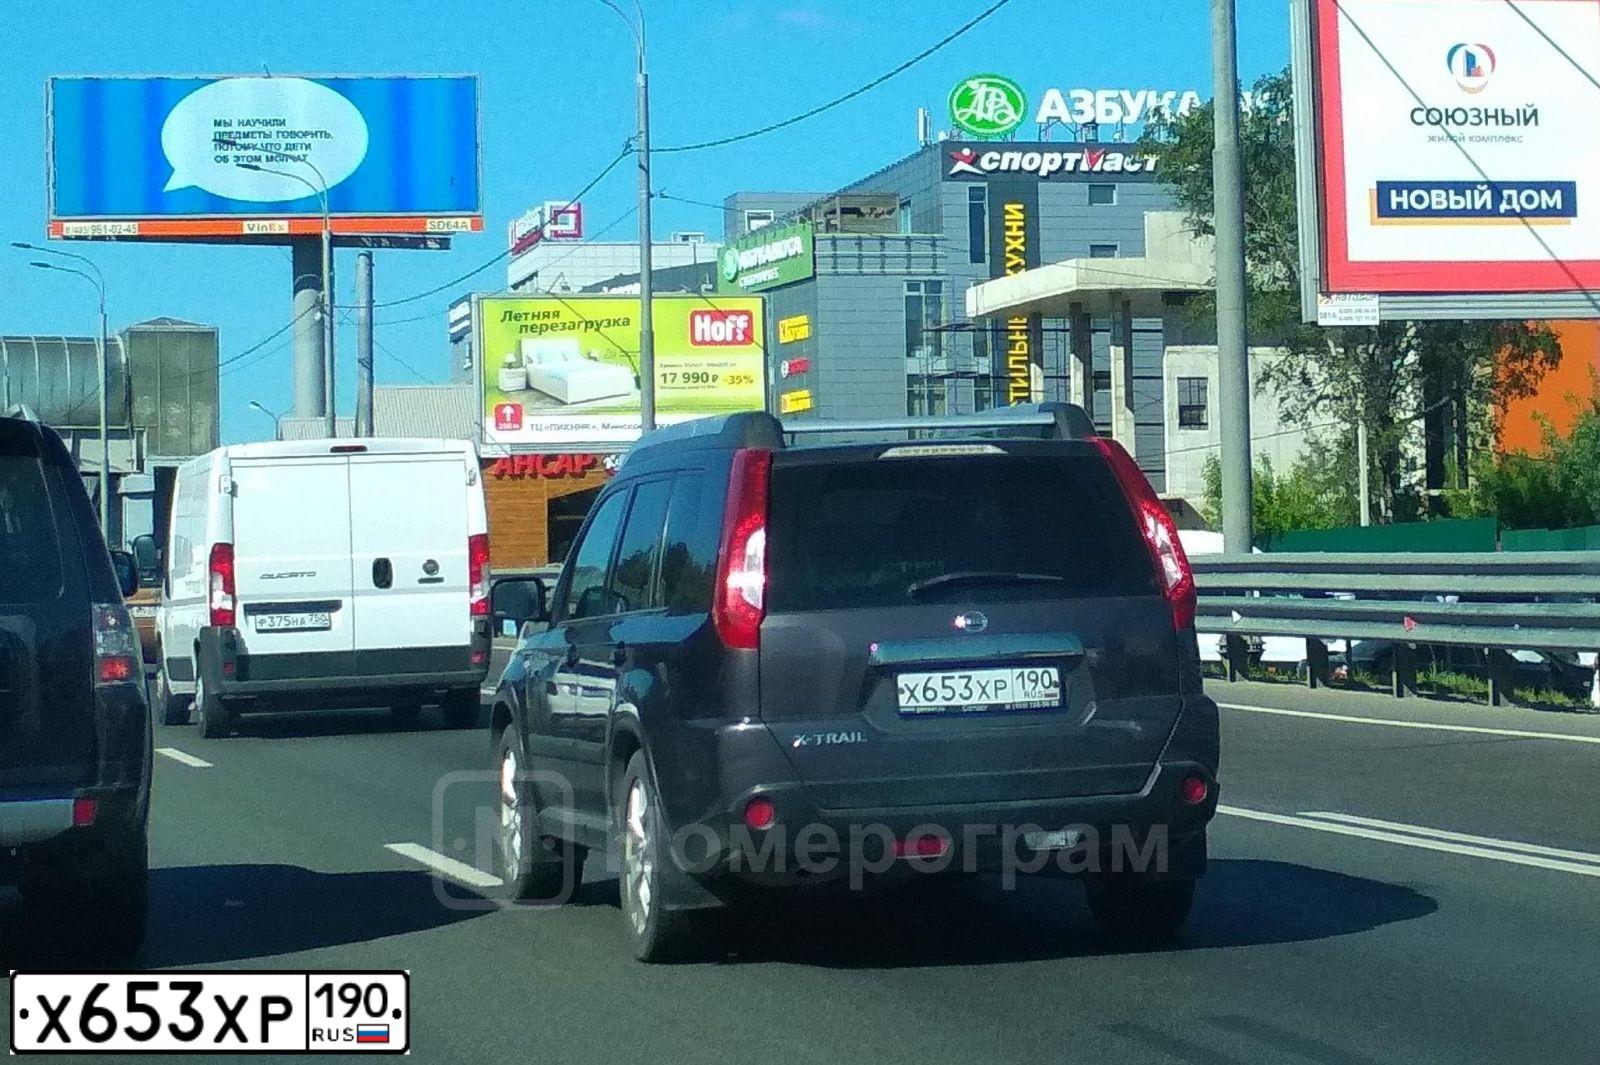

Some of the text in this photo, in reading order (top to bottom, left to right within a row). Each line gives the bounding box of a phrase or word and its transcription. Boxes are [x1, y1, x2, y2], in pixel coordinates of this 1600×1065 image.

[1410, 103, 1539, 126] СОЮЗНЫЙ
[213, 119, 286, 127] МЫ НАУЧИЛИ
[213, 131, 272, 140] ПРЕДМЕТЫ
[1427, 133, 1466, 143] жилой
[260, 143, 281, 151] ЧТО
[284, 143, 312, 151] ДЕТИ
[213, 155, 229, 163] ОБ
[233, 155, 262, 163] ЭТОМ
[1390, 185, 1563, 213] НОВЫЙ ДОМ
[500, 310, 561, 323] Летняя
[519, 316, 631, 334] перезагрузка
[694, 314, 749, 342] Hoff
[660, 372, 678, 384] 17
[682, 372, 710, 384] 990
[492, 454, 597, 478] АНСАР
[1015, 669, 1052, 691] 190
[793, 731, 868, 748] X-TRAIL
